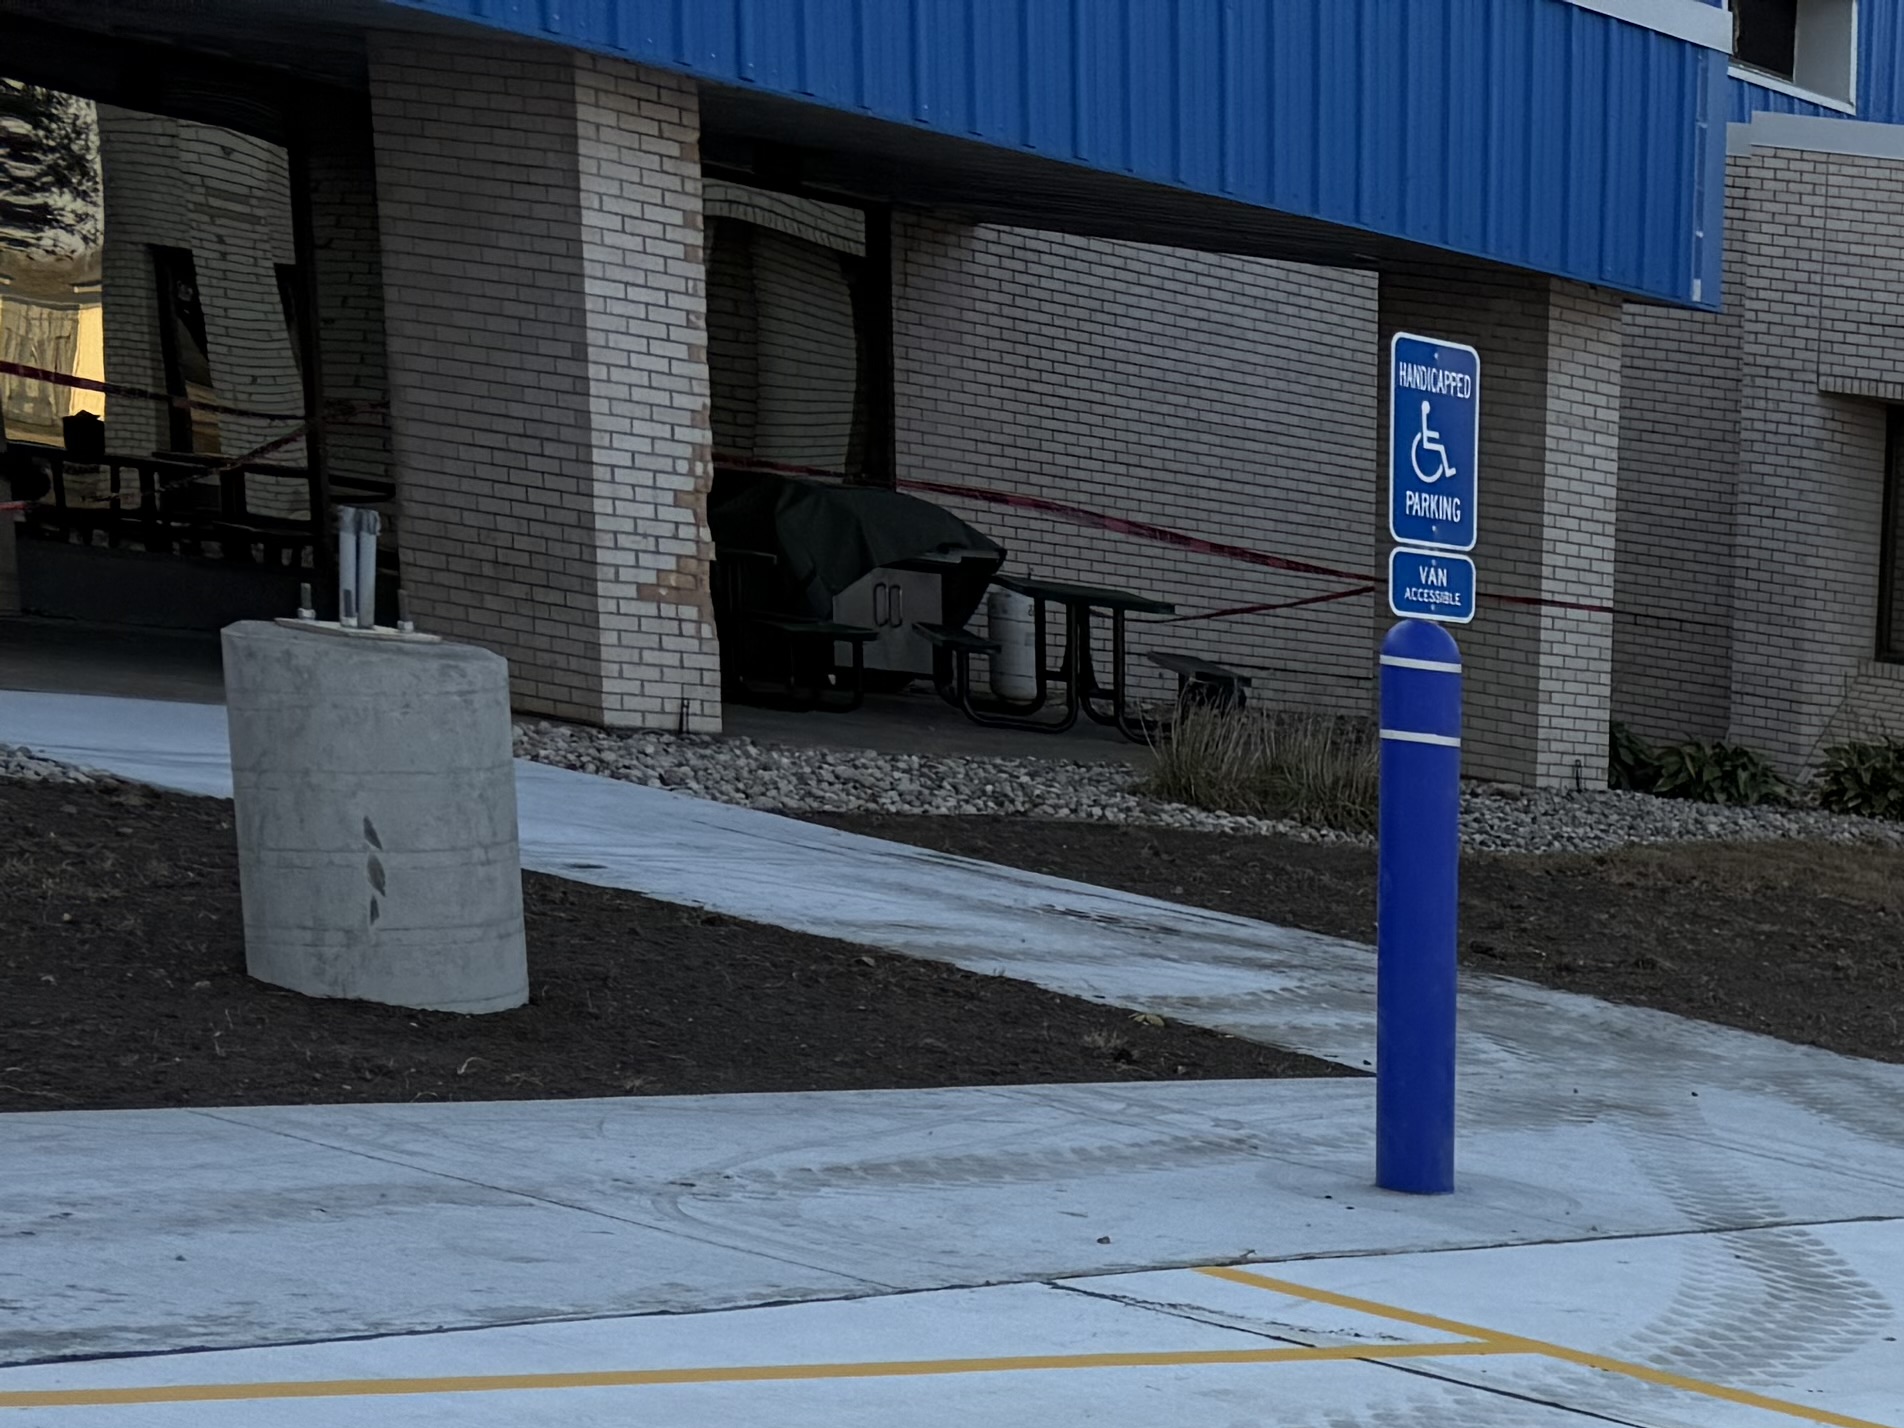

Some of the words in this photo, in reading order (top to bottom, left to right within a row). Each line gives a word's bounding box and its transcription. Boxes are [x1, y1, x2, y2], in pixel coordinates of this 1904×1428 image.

[1399, 362, 1472, 399] HANDICAPPED
[1405, 490, 1461, 523] PARKING
[1419, 565, 1447, 588] VAN
[1404, 587, 1462, 606] ACCESSIBLE
